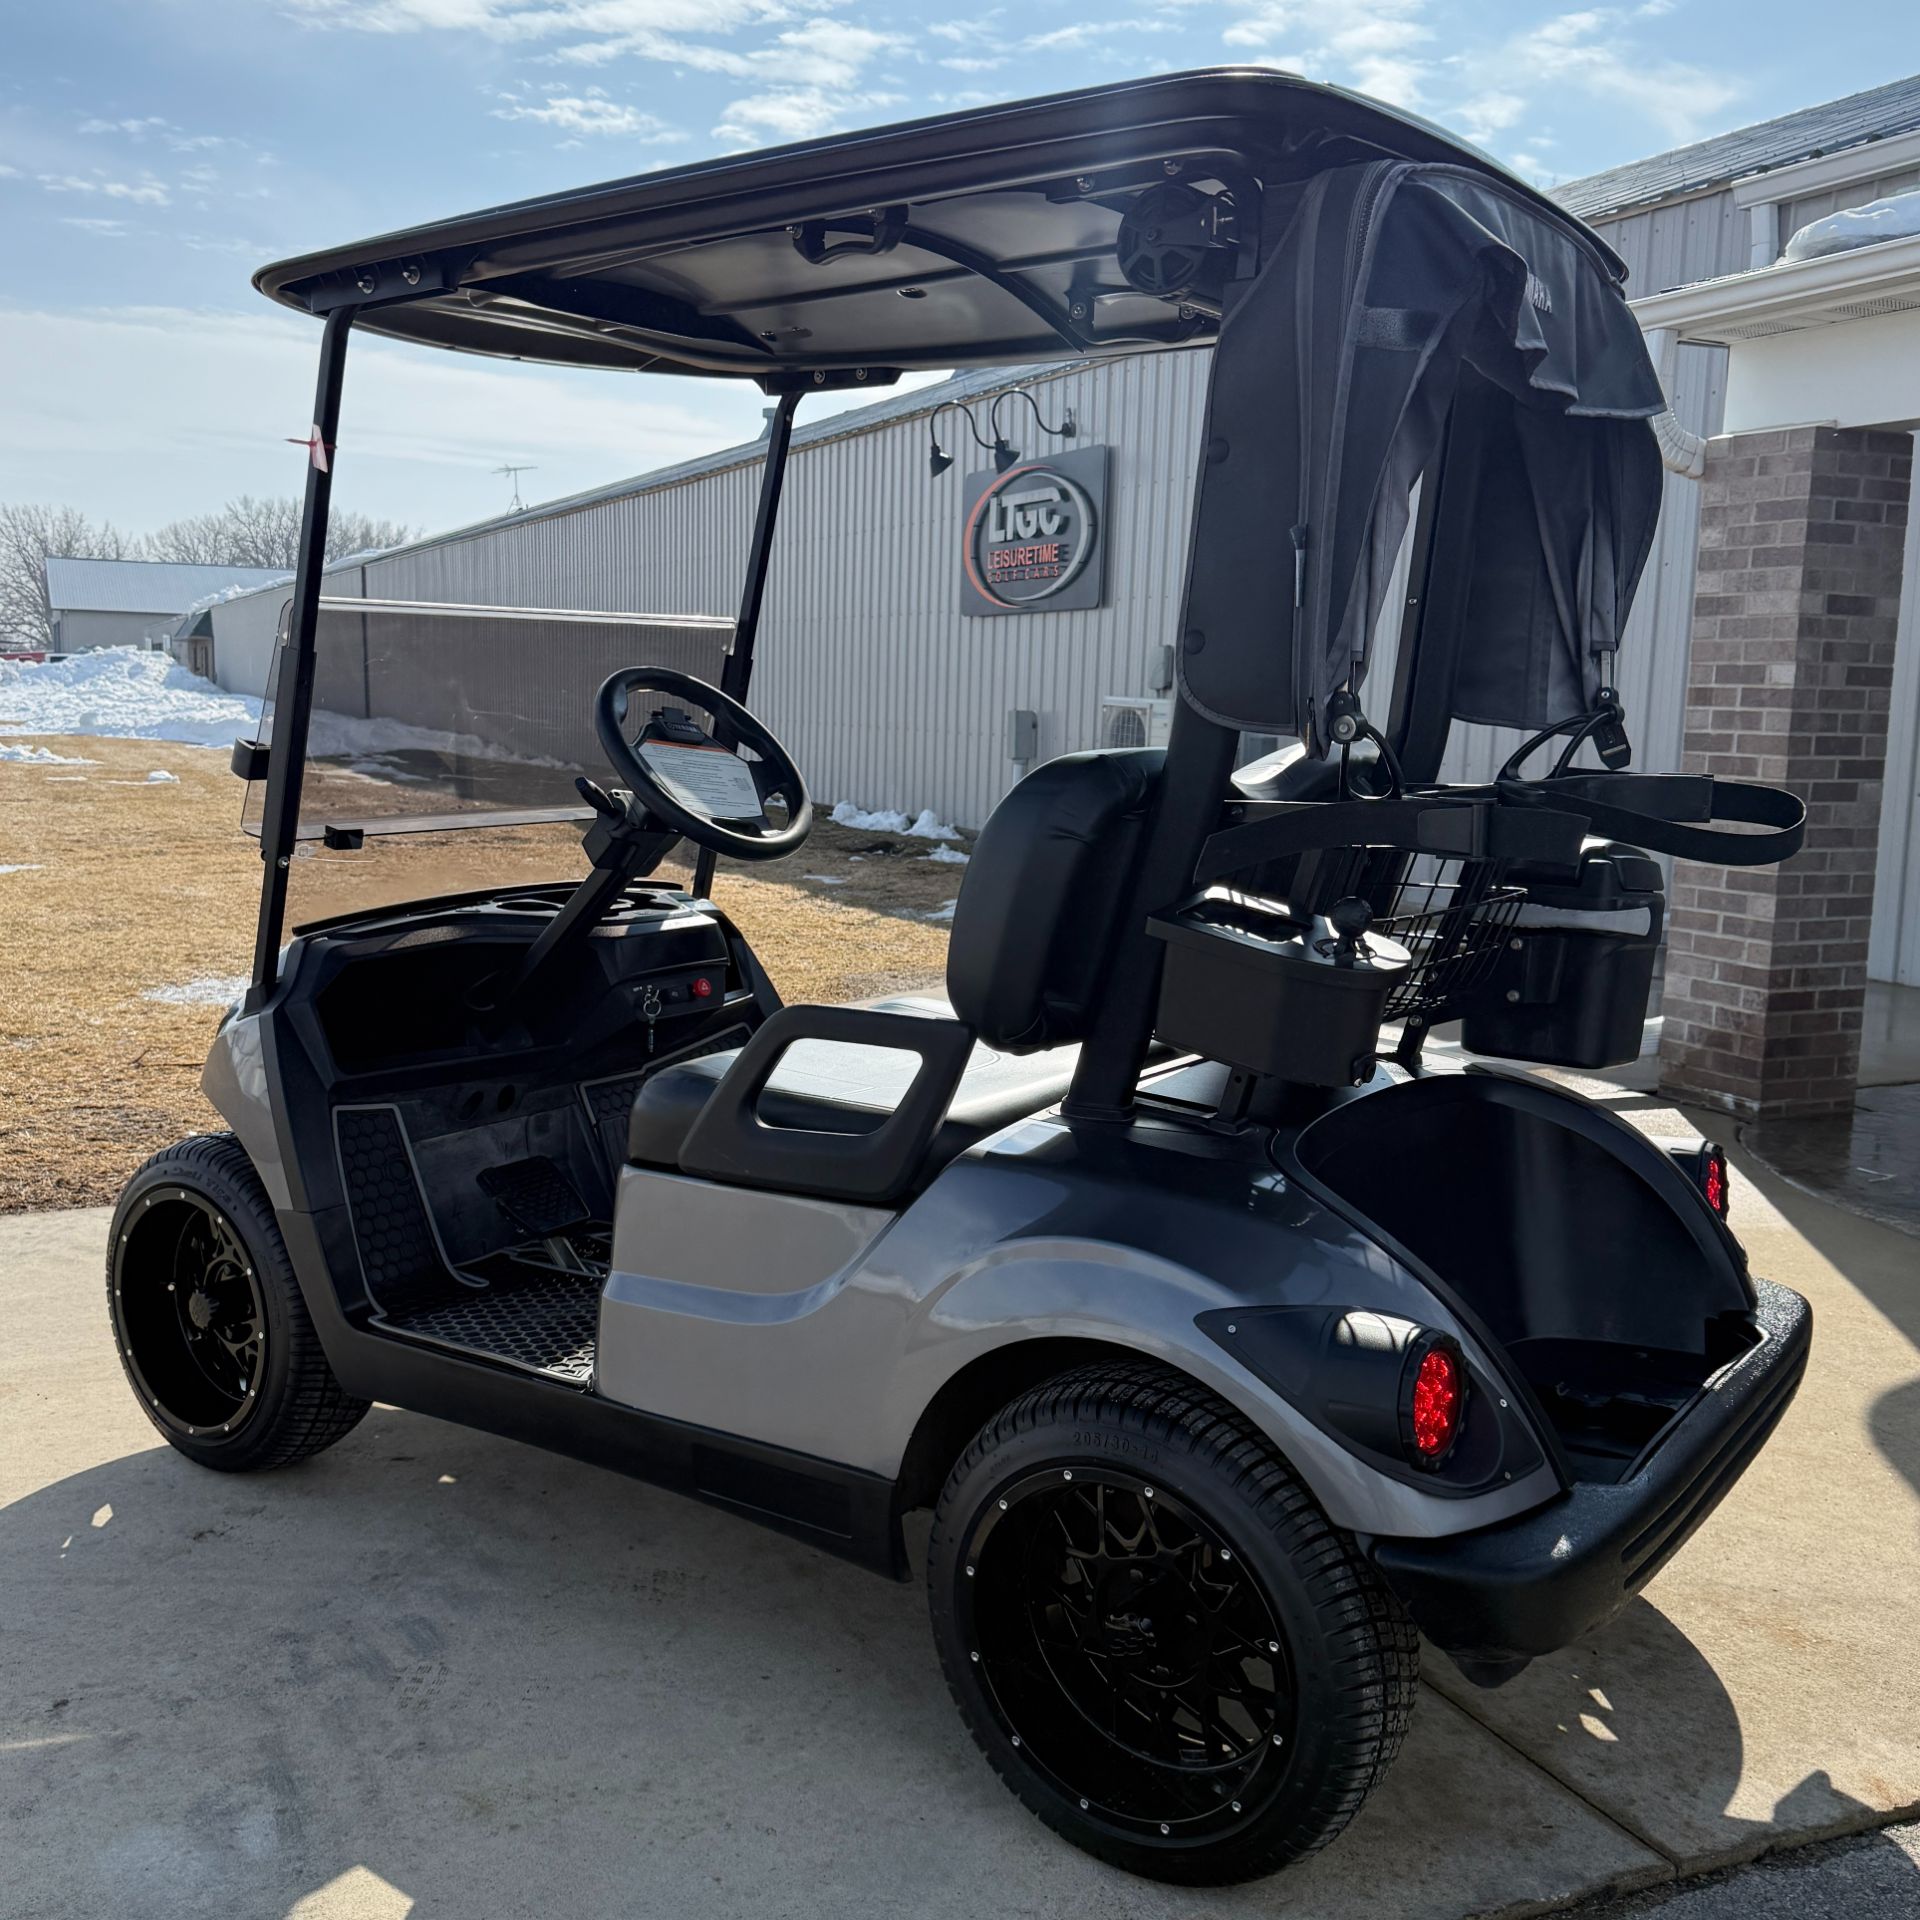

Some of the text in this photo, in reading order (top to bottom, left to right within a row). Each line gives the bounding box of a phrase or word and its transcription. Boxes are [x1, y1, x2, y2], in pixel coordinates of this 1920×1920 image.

[988, 487, 1061, 543] LTGC
[987, 543, 1059, 569] LEISURETIME
[986, 565, 1060, 583] GOLF CARS
